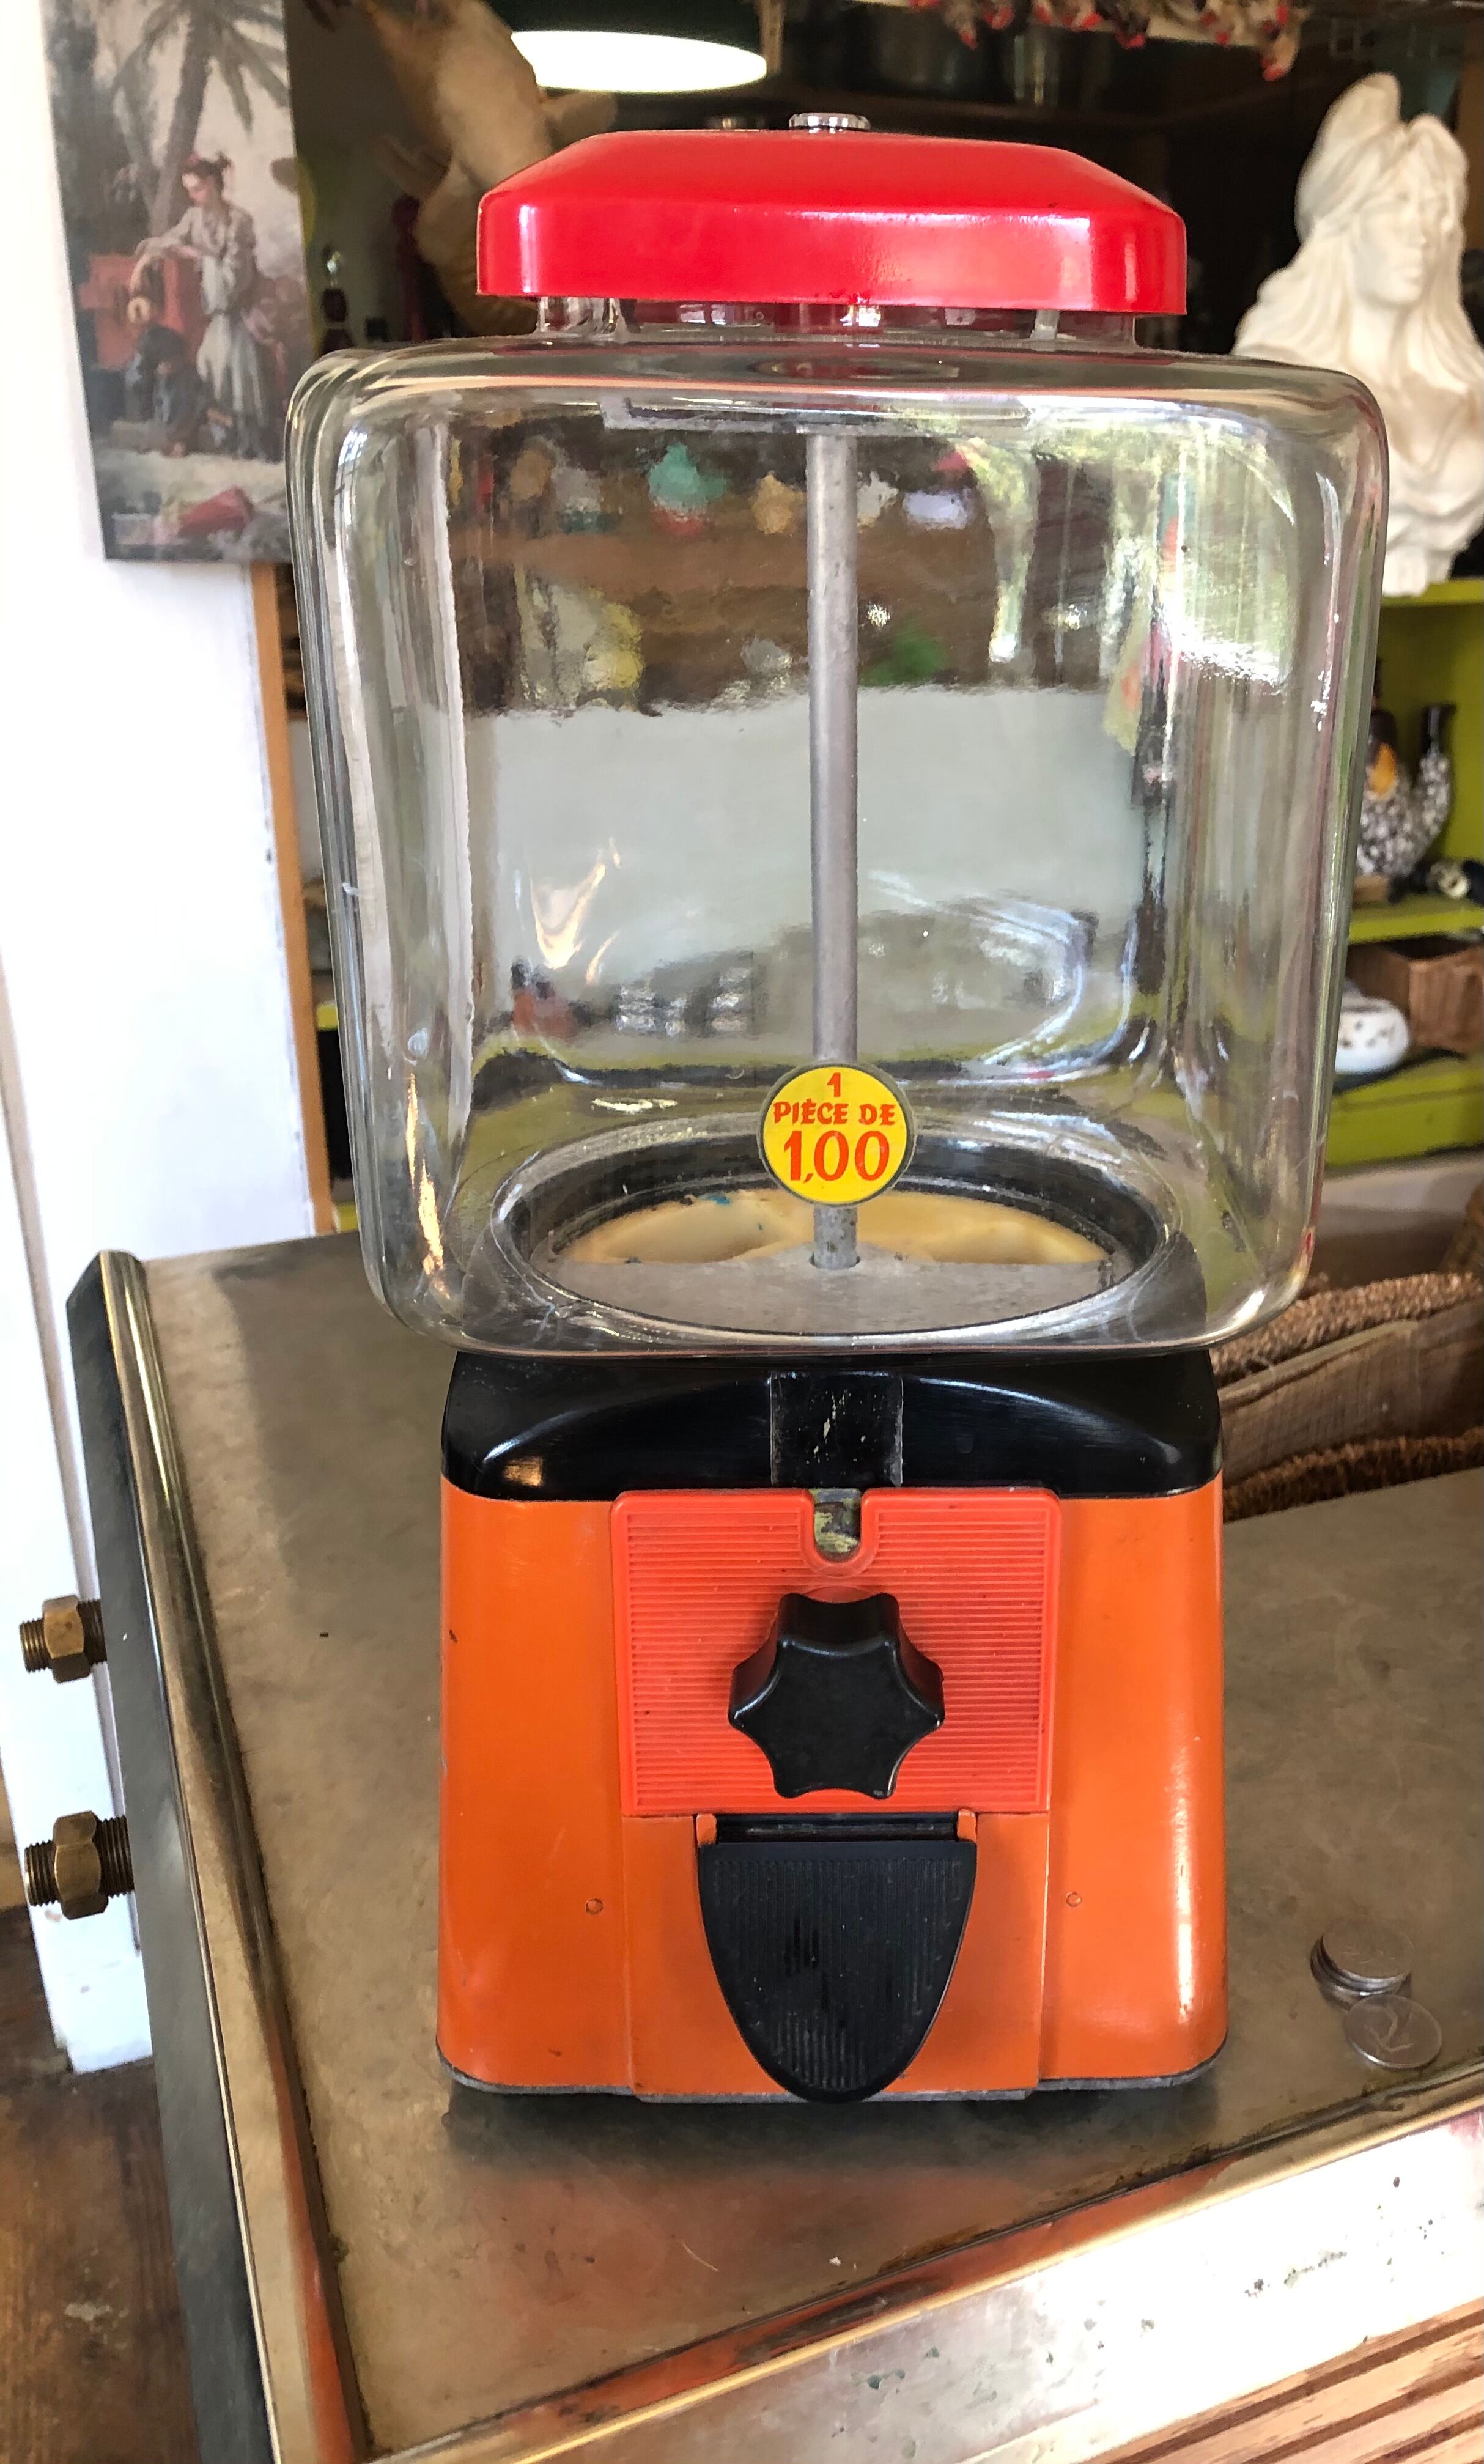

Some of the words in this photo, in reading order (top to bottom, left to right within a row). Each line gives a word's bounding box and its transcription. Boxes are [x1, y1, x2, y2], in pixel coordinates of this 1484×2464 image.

[827, 1072, 841, 1097] 1
[858, 1104, 895, 1125] DE
[784, 1130, 890, 1182] 1,00
